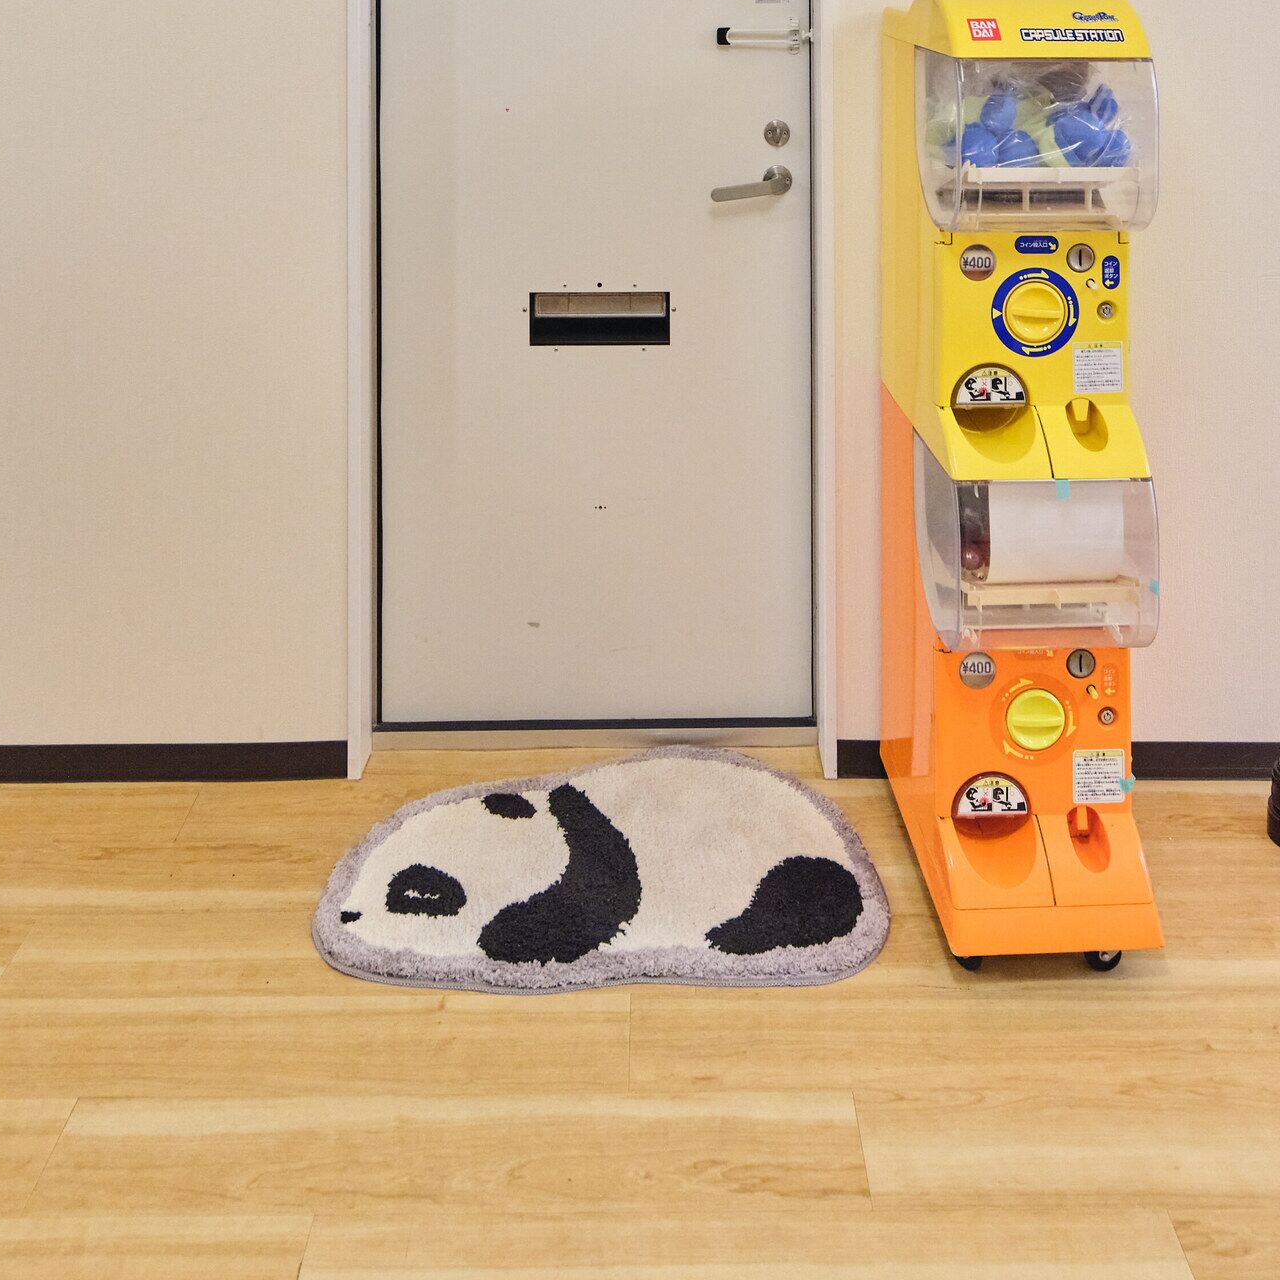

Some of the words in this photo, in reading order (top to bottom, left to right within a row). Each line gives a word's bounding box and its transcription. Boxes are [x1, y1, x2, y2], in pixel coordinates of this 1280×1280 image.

[969, 20, 997, 29] BAN
[972, 29, 994, 38] DAI
[1020, 29, 1075, 41] CAPSULE
[1075, 29, 1124, 41] STATION
[962, 256, 992, 269] ¥400
[962, 661, 992, 674] ¥400
